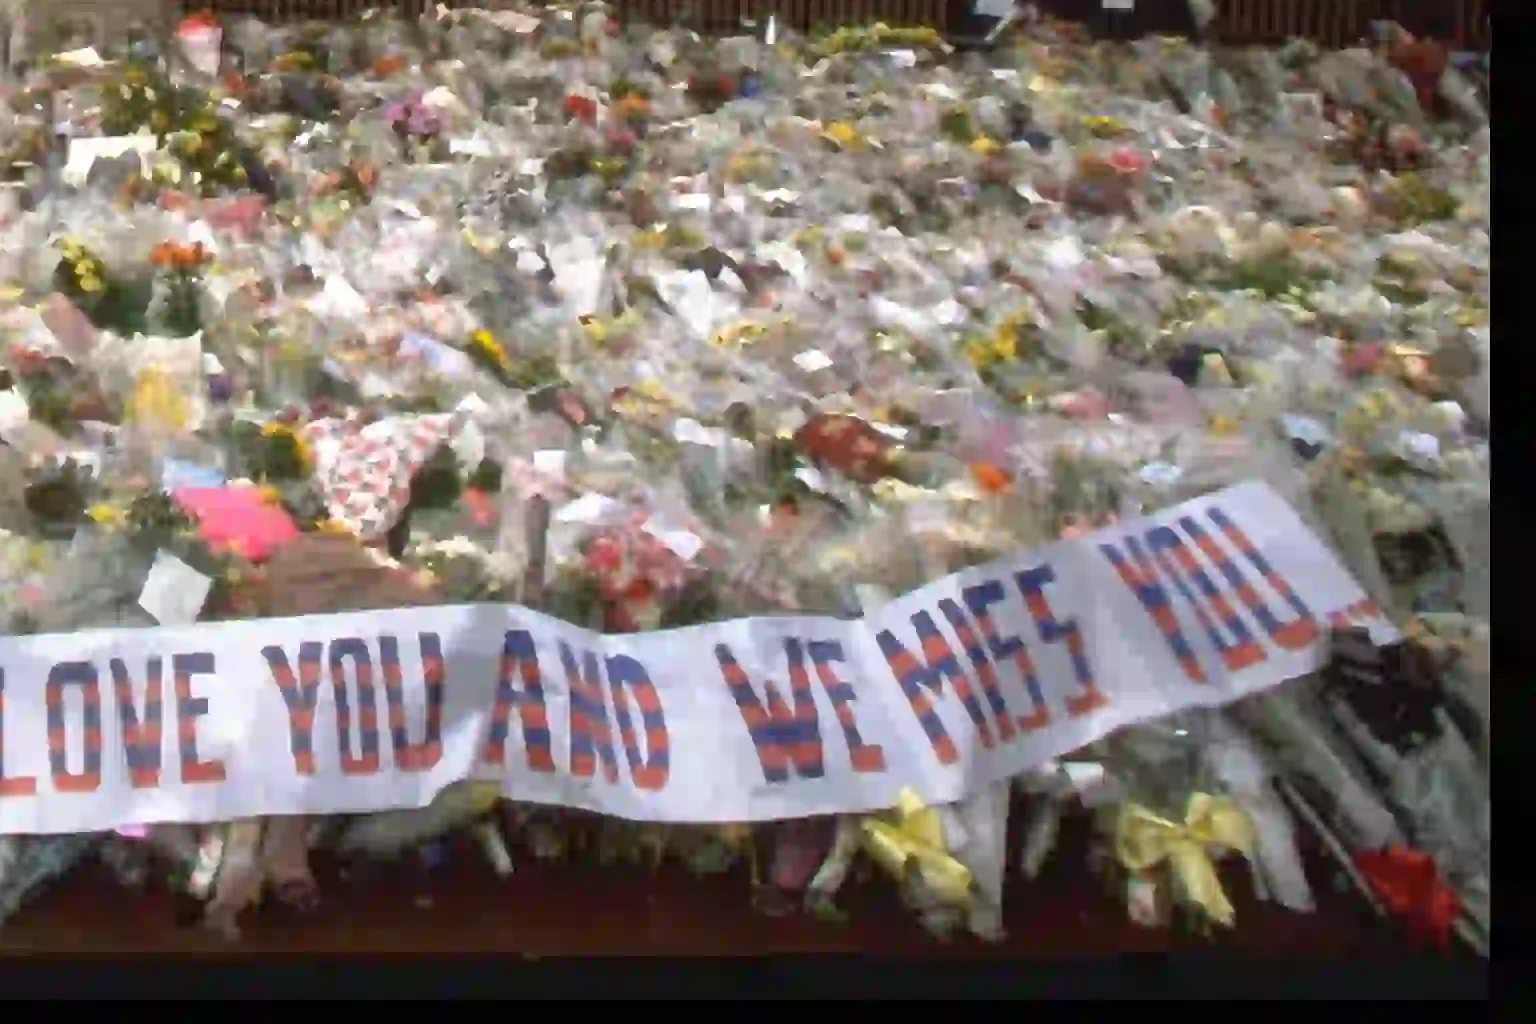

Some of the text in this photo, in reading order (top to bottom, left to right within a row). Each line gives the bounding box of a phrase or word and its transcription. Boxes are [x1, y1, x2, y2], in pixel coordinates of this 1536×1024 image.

[261, 631, 444, 774] YOU
[483, 629, 671, 792] AND
[714, 636, 886, 782] WE
[875, 563, 1109, 765] MISS
[1099, 506, 1318, 682] YOU
